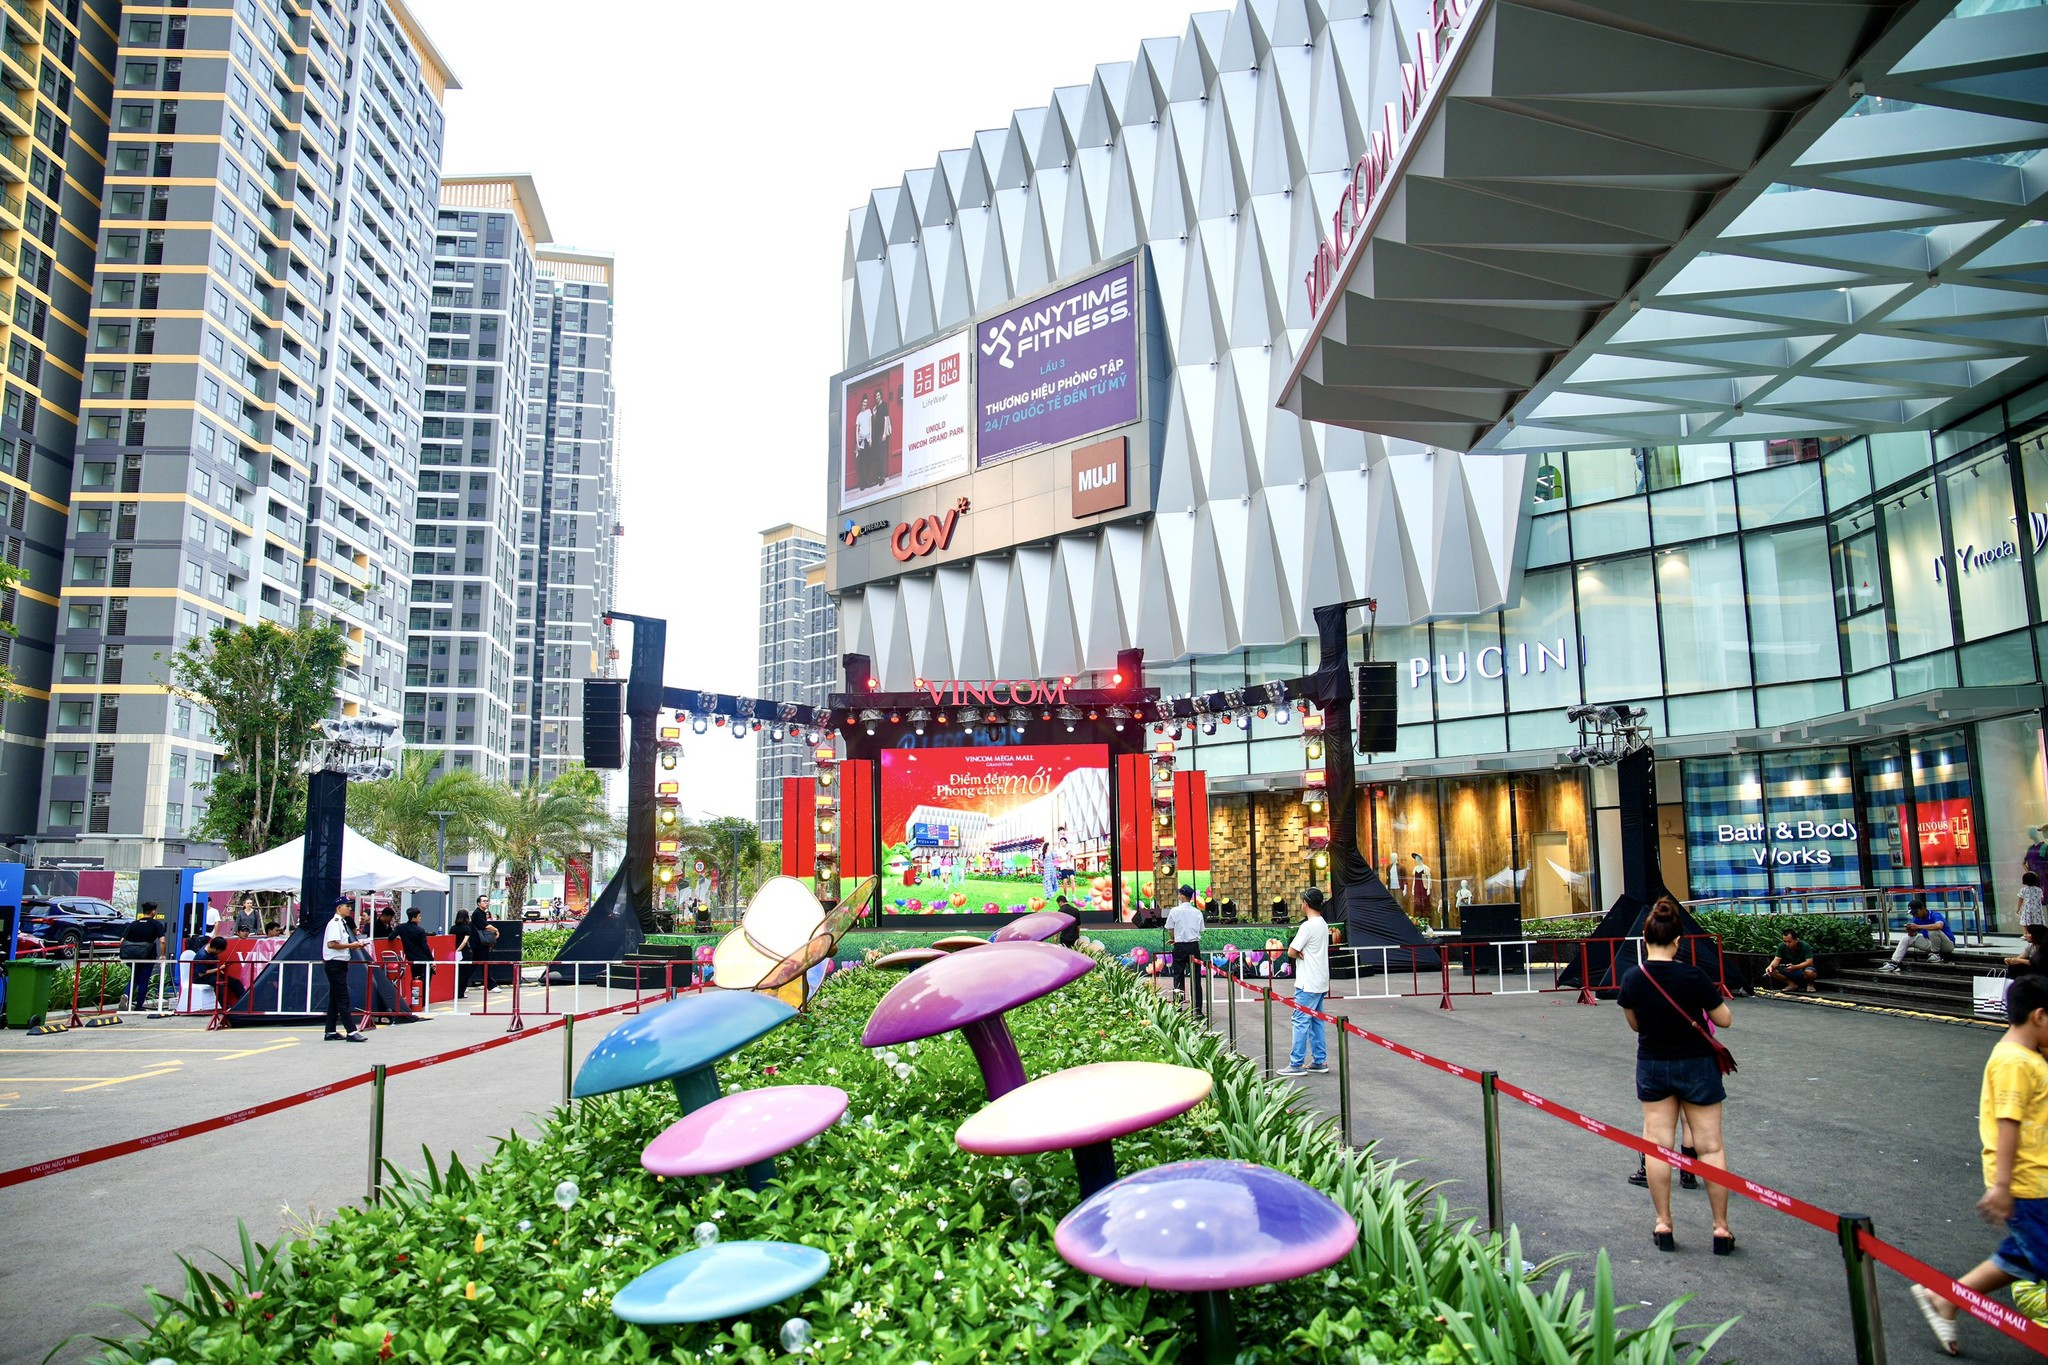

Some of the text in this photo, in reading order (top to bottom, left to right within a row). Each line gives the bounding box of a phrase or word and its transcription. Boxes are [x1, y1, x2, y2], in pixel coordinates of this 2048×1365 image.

[1018, 276, 1128, 337] ANYTIME
[1017, 299, 1130, 358] FITNESS
[940, 357, 957, 372] UNI
[1059, 358, 1066, 368] 3
[940, 369, 958, 385] QLO
[985, 358, 1124, 416] THƯƠNG HIỆU PHÒNG TẬP
[922, 393, 948, 409] LifeWear
[984, 371, 1128, 433] 24/7 QUỐC TẾ ĐẾN TỪ MỸ
[908, 425, 964, 452] VINCOM GRAND PARK
[925, 420, 946, 434] UNIQLO
[1078, 462, 1117, 492] MUJI
[860, 520, 889, 536] CINEMAS
[890, 508, 960, 562] CGV
[924, 679, 1069, 706] VINCOM
[965, 754, 1035, 763] VINCOM MEGA MALL
[949, 772, 1006, 785] Điểm đến
[1002, 766, 1053, 796] mới
[936, 785, 1004, 798] Phong cách
[1775, 821, 1794, 840] &
[1797, 818, 1858, 841] Body
[1752, 846, 1832, 866] Works
[1951, 1281, 2027, 1332] VINCOM MEGA MALL
